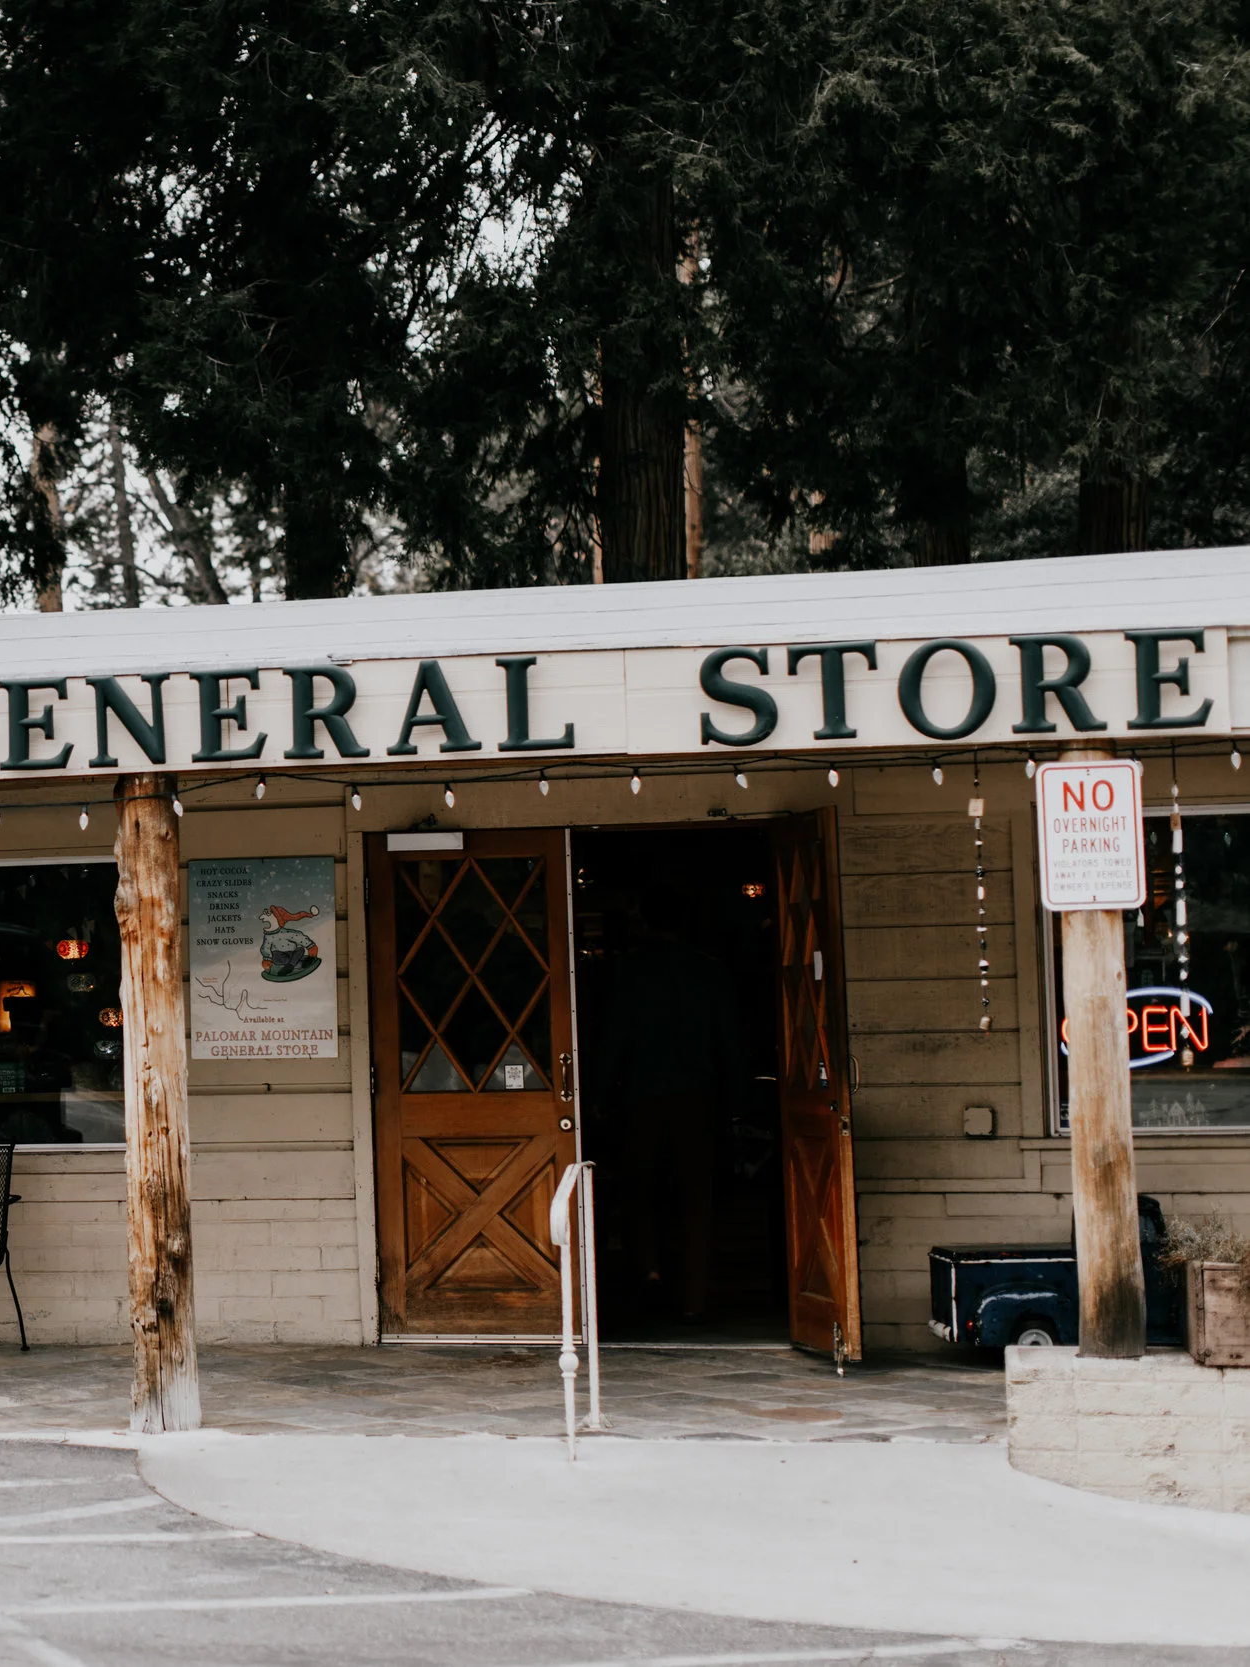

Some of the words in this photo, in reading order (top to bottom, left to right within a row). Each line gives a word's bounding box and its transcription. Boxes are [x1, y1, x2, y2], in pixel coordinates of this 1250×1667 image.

[699, 628, 1214, 746] STORE
[1062, 779, 1114, 812] NO
[1053, 816, 1127, 834] OVERNIGHT
[1062, 837, 1120, 853] PARKING
[1053, 858, 1099, 868] VIOLATORS
[1104, 857, 1131, 867] TOWED
[200, 867, 218, 875] HOT
[220, 867, 248, 875] COCOA
[1055, 871, 1076, 879] AWAY
[1082, 870, 1091, 878] AT
[1096, 869, 1132, 879] VEHICLE
[224, 879, 252, 887] SLIDES
[1094, 881, 1133, 891] EXPENSE
[207, 891, 239, 899] SNACKS
[209, 902, 240, 910] DRINKS
[207, 914, 242, 923] JACKETS
[214, 926, 236, 934] HATS
[196, 938, 220, 946] SNOW
[222, 937, 254, 945] GLOVES
[243, 1016, 275, 1024] Available
[1061, 1005, 1209, 1052] EN
[195, 1030, 257, 1042] PALOMAR
[261, 1029, 334, 1041] MOUNTAIN
[210, 1045, 272, 1057] GENERAL
[276, 1044, 319, 1056] STORE
